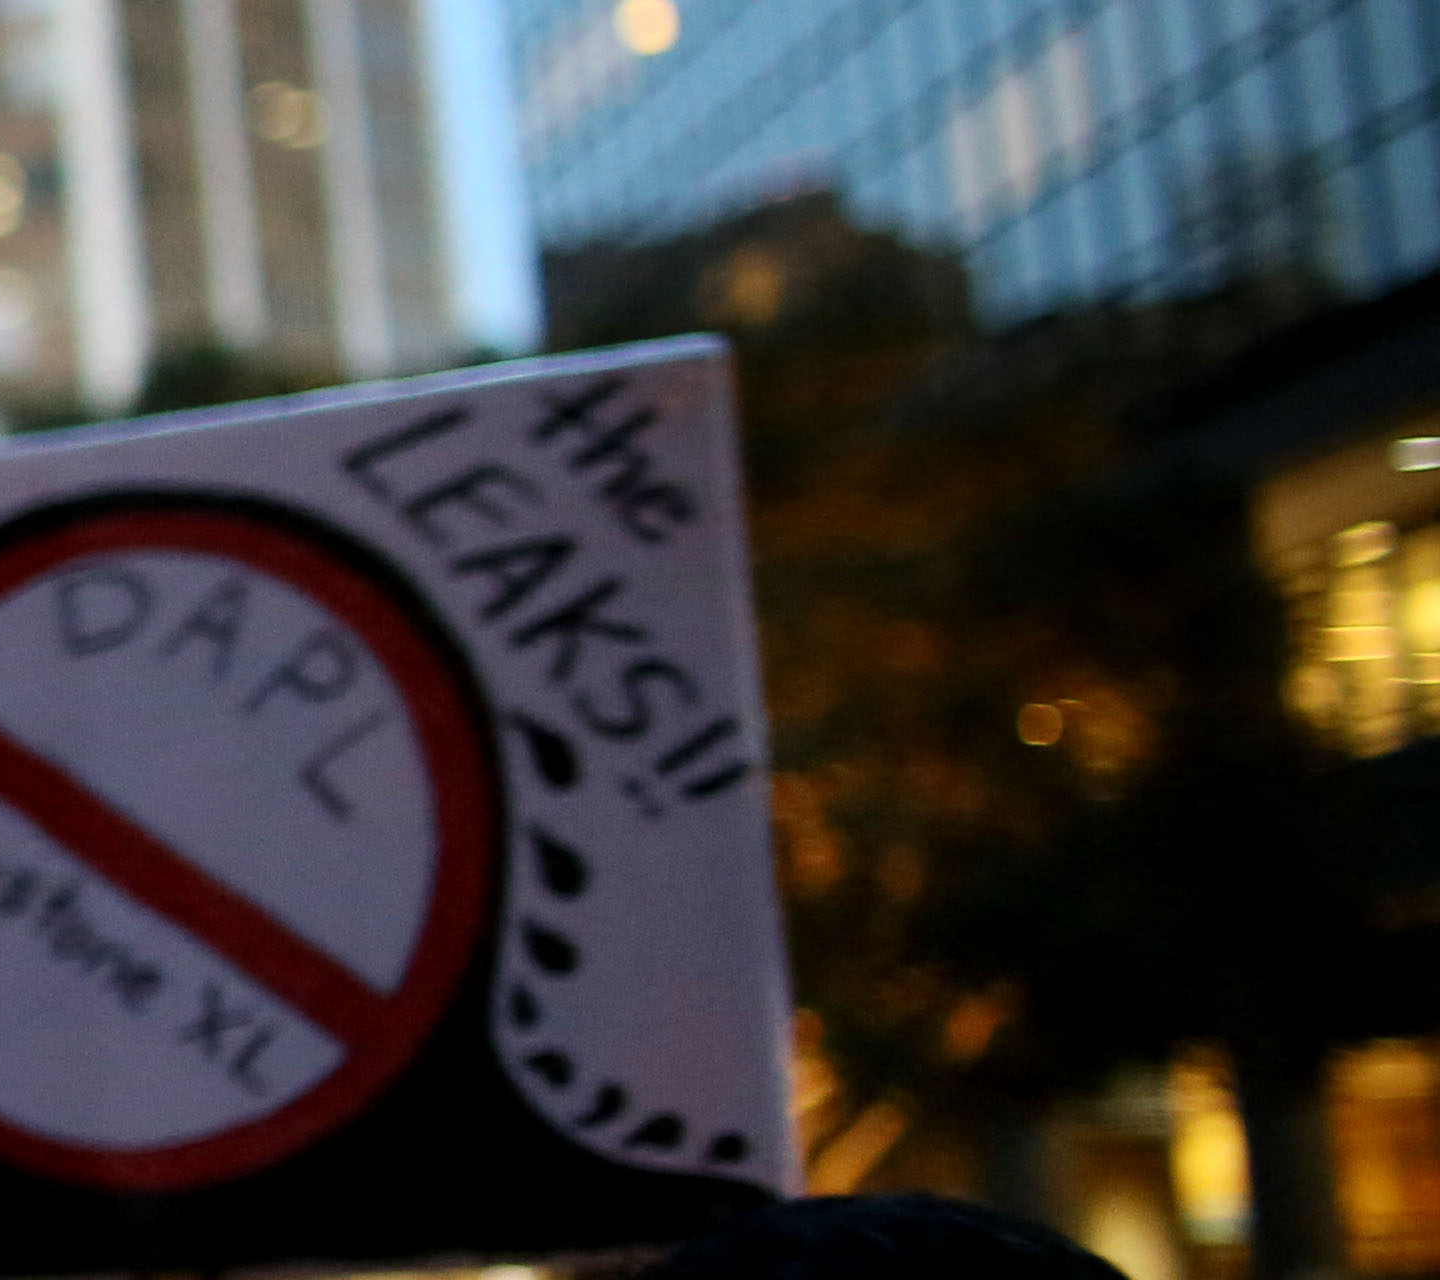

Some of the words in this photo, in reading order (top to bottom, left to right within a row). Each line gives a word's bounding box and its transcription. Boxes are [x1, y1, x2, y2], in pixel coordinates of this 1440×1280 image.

[528, 379, 693, 547] the
[53, 566, 391, 823] DAPL
[177, 975, 287, 1097] XL
